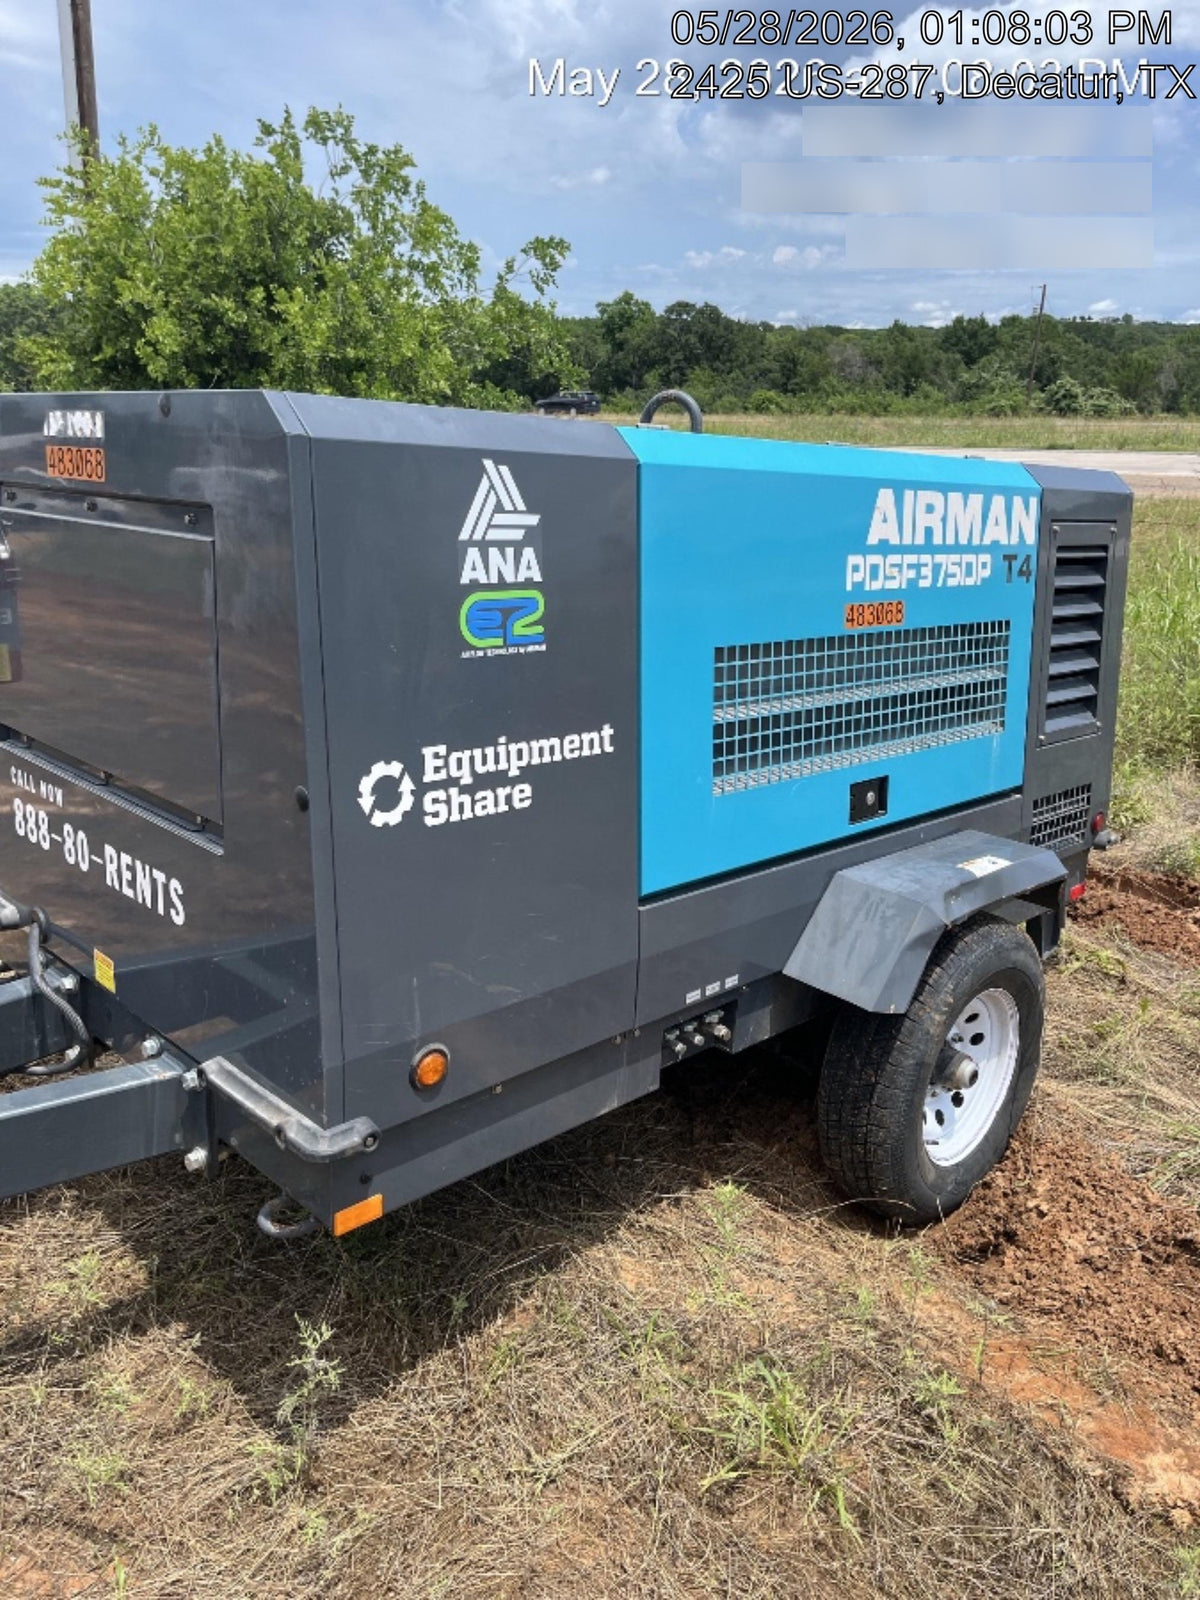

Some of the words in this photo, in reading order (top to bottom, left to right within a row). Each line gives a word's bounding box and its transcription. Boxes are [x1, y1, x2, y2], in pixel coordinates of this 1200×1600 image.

[48, 447, 104, 479] 483068
[866, 488, 1038, 546] AIRMAN
[460, 547, 543, 585] ANA
[846, 553, 992, 592] PDSF375DP
[1002, 554, 1032, 584] T4
[845, 600, 904, 628] 483068
[421, 723, 615, 785] Equipment
[10, 765, 36, 794] CALL
[40, 779, 63, 808] NOW
[422, 782, 533, 827] Share
[13, 797, 186, 926] 888-80-RENTS
